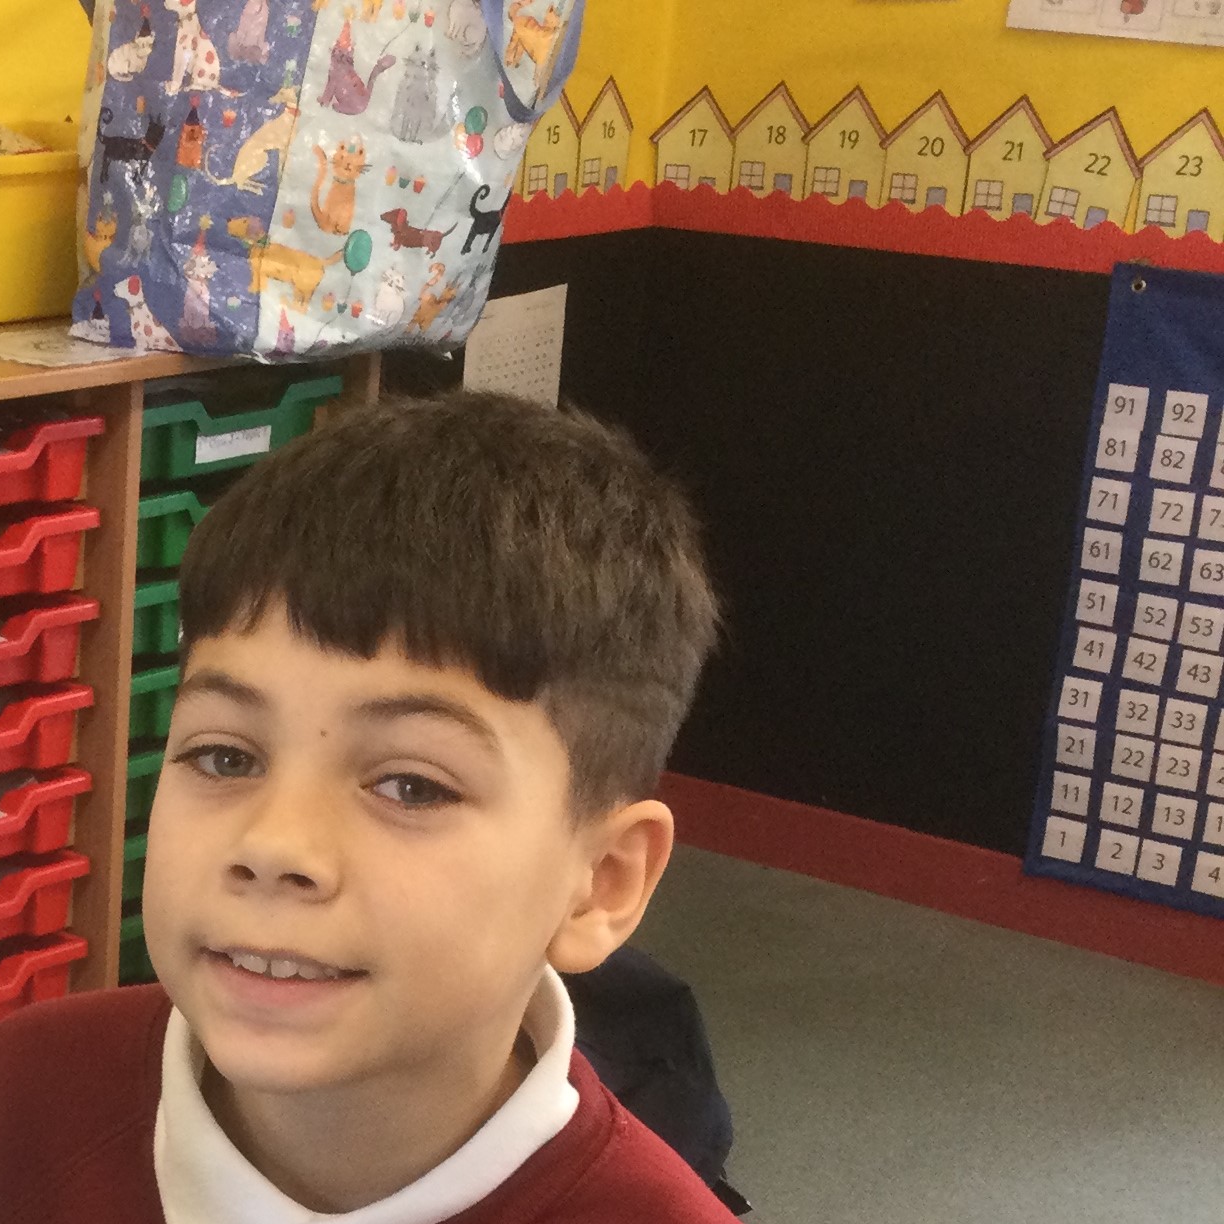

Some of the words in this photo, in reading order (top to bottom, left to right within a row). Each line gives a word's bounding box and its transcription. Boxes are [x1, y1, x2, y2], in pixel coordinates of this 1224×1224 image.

[547, 125, 560, 144] 15
[602, 120, 615, 139] 16
[689, 128, 708, 147] 17
[766, 125, 786, 145] 18
[840, 129, 859, 149] 19
[917, 136, 944, 157] 20
[1002, 140, 1024, 162] 21
[1084, 153, 1111, 176] 22
[1176, 155, 1203, 177] 23
[1114, 396, 1135, 416] 91
[1172, 403, 1196, 423] 92
[1104, 438, 1126, 457] 81
[1160, 449, 1185, 469] 82
[1097, 490, 1118, 511] 71
[1159, 502, 1183, 522] 72
[1210, 508, 1224, 528] 7
[1089, 541, 1110, 560] 61
[1148, 551, 1173, 571] 62
[1199, 562, 1224, 582] 63
[1085, 592, 1106, 612] 51
[1143, 606, 1167, 627] 52
[1189, 616, 1214, 637] 53
[1083, 641, 1105, 660] 41
[1132, 651, 1157, 672] 42
[1186, 664, 1211, 684] 43
[1067, 687, 1089, 708] 31
[1125, 700, 1149, 721] 32
[1170, 712, 1196, 731] 33
[1064, 736, 1085, 755] 21
[1121, 747, 1144, 768] 22
[1166, 757, 1190, 777] 23
[1060, 784, 1080, 803] 11
[1112, 794, 1134, 815] 12
[1163, 806, 1185, 826] 13
[1059, 831, 1067, 848] 1
[1111, 843, 1123, 860] 2
[1152, 853, 1165, 871] 3
[1208, 866, 1221, 883] 4
